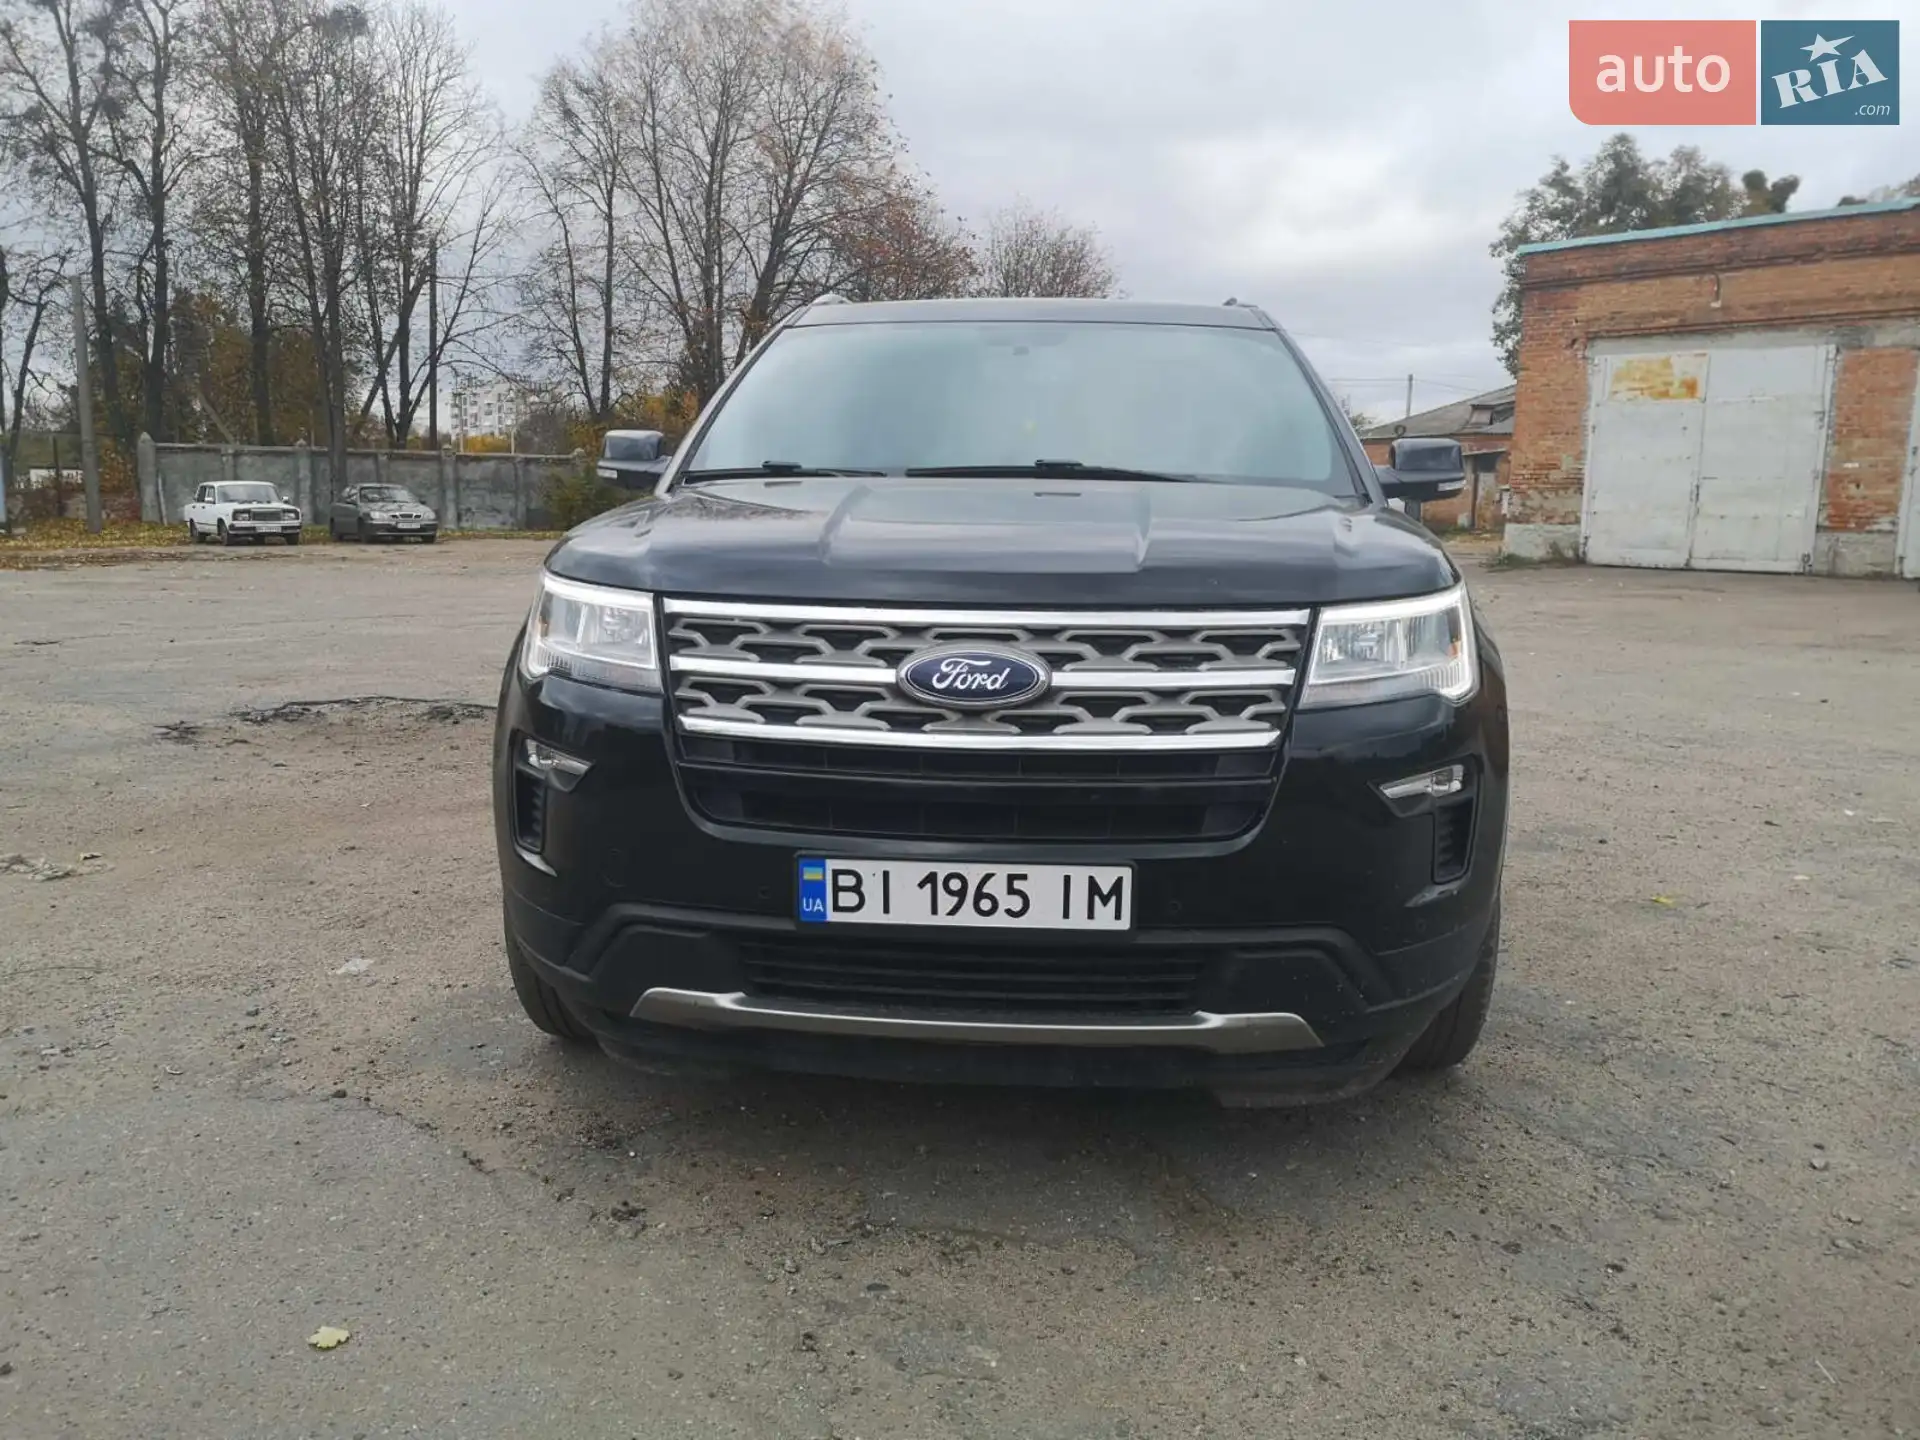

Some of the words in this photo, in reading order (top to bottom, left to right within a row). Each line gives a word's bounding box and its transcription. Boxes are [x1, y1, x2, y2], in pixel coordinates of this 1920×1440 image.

[931, 657, 1011, 690] Ford
[802, 897, 824, 912] UA
[831, 868, 891, 915] BI
[916, 870, 1031, 919] 1965
[1062, 874, 1124, 921] IM
